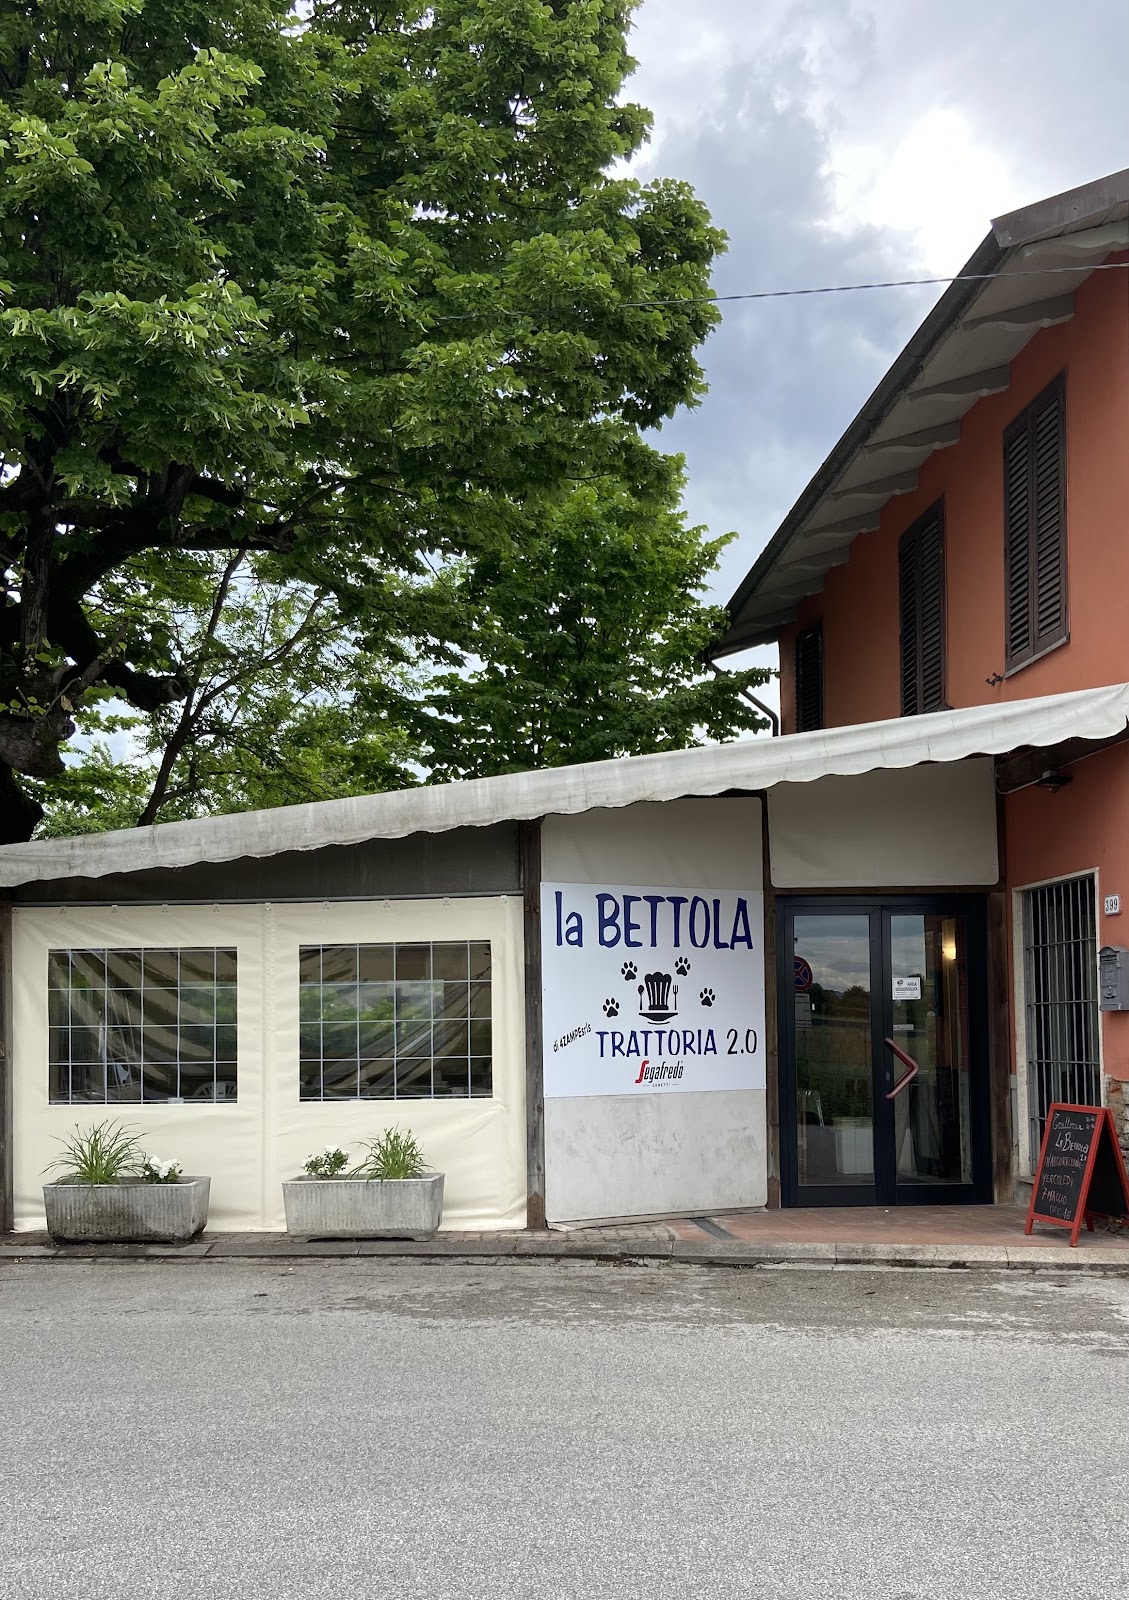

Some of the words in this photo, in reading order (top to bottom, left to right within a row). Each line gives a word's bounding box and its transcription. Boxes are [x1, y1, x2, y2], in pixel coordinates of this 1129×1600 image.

[1105, 897, 1118, 912] 399
[554, 891, 583, 947] la
[595, 893, 753, 950] BETTOLA
[595, 1029, 718, 1058] TRATTORIA
[726, 1028, 758, 1055] 2.0
[635, 1060, 684, 1083] Segafredo
